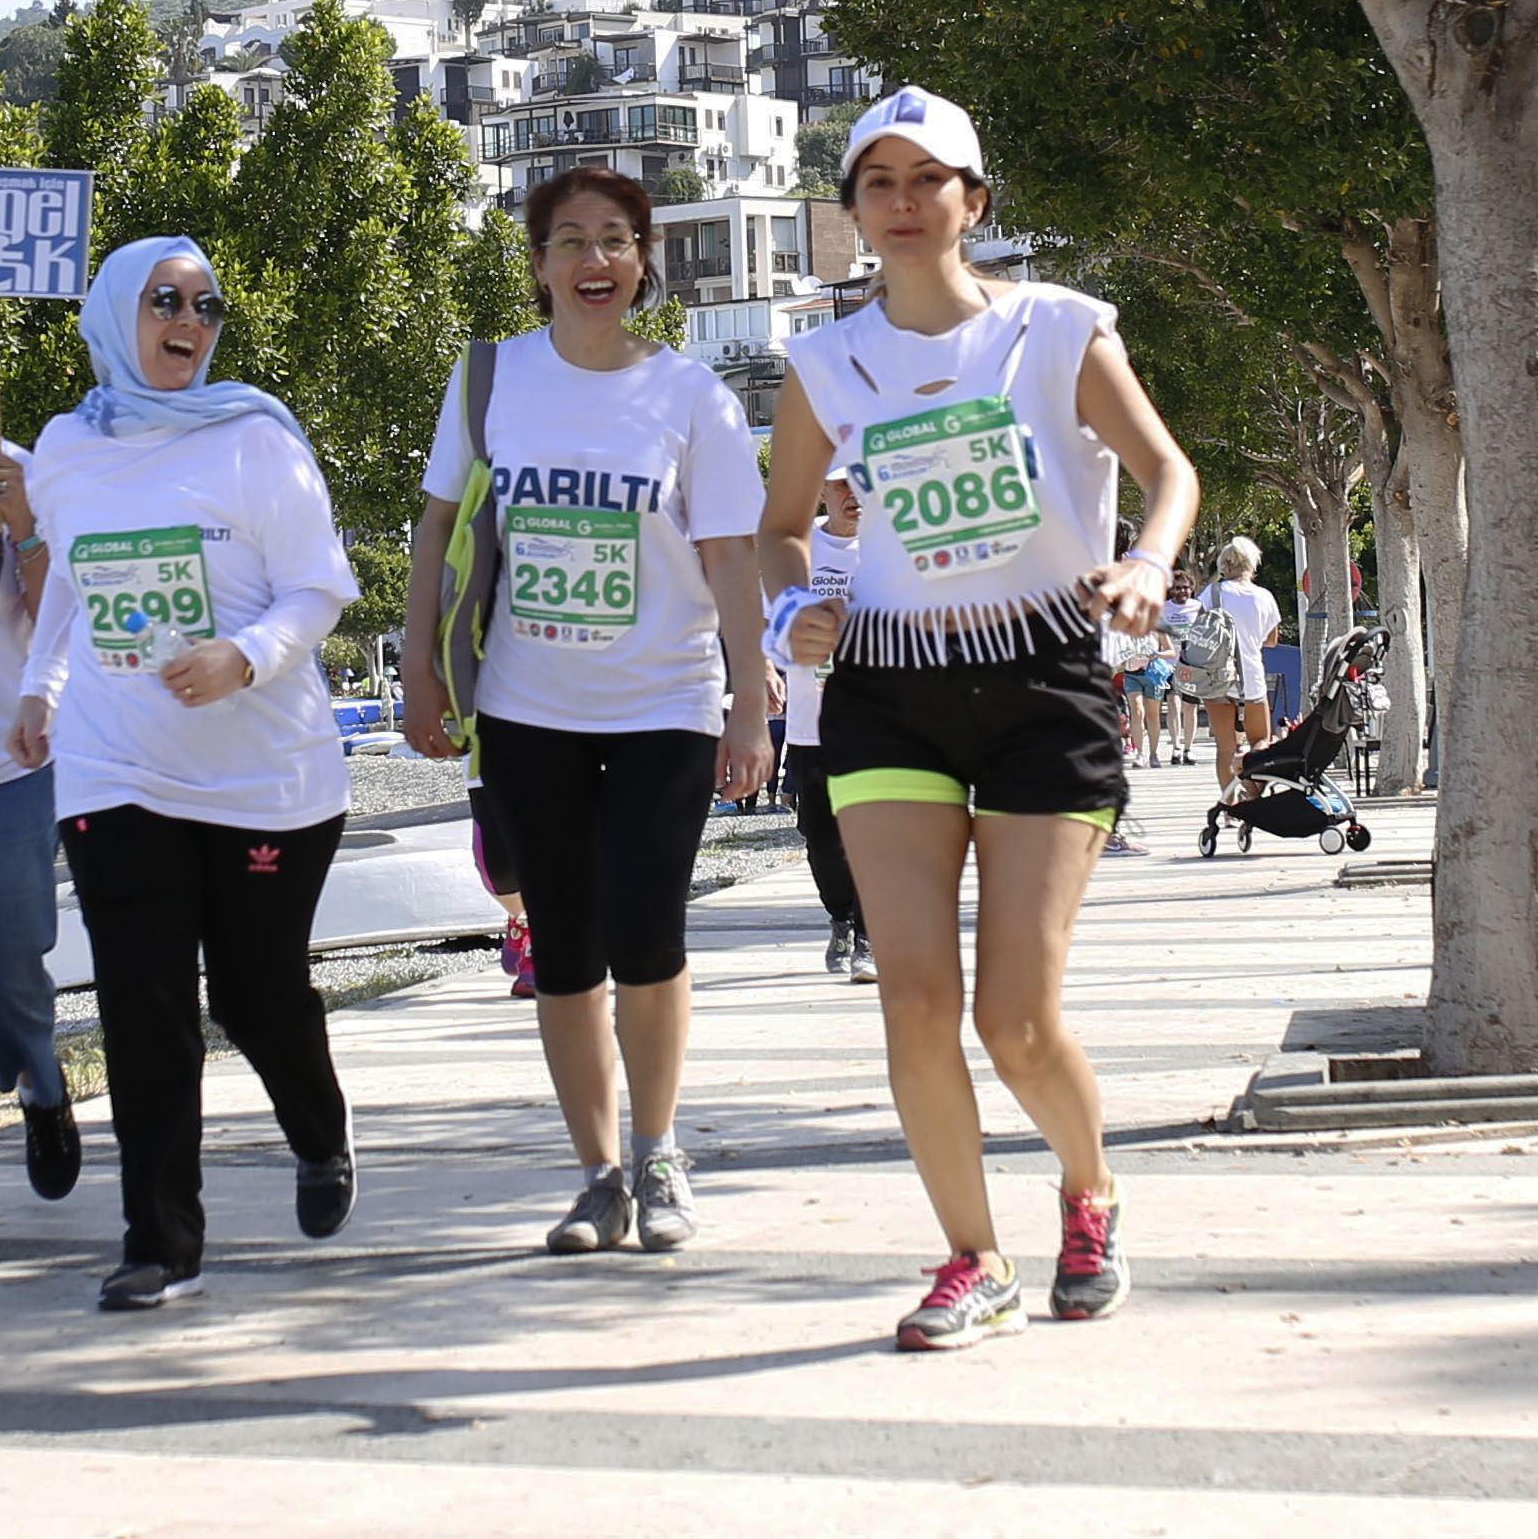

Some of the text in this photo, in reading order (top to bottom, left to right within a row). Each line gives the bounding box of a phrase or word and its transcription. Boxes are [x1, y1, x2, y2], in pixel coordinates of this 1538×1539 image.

[886, 421, 937, 442] GLOBAL
[969, 434, 1011, 463] 5K
[493, 466, 661, 513] PARILTI
[884, 465, 1027, 533] 2086
[527, 517, 572, 530] GLOBAL
[90, 541, 134, 554] GLOBAL
[593, 543, 628, 564] 5K
[158, 561, 194, 583] 5K
[812, 576, 848, 586] Global
[514, 563, 632, 609] 2346
[87, 587, 203, 633] 2699
